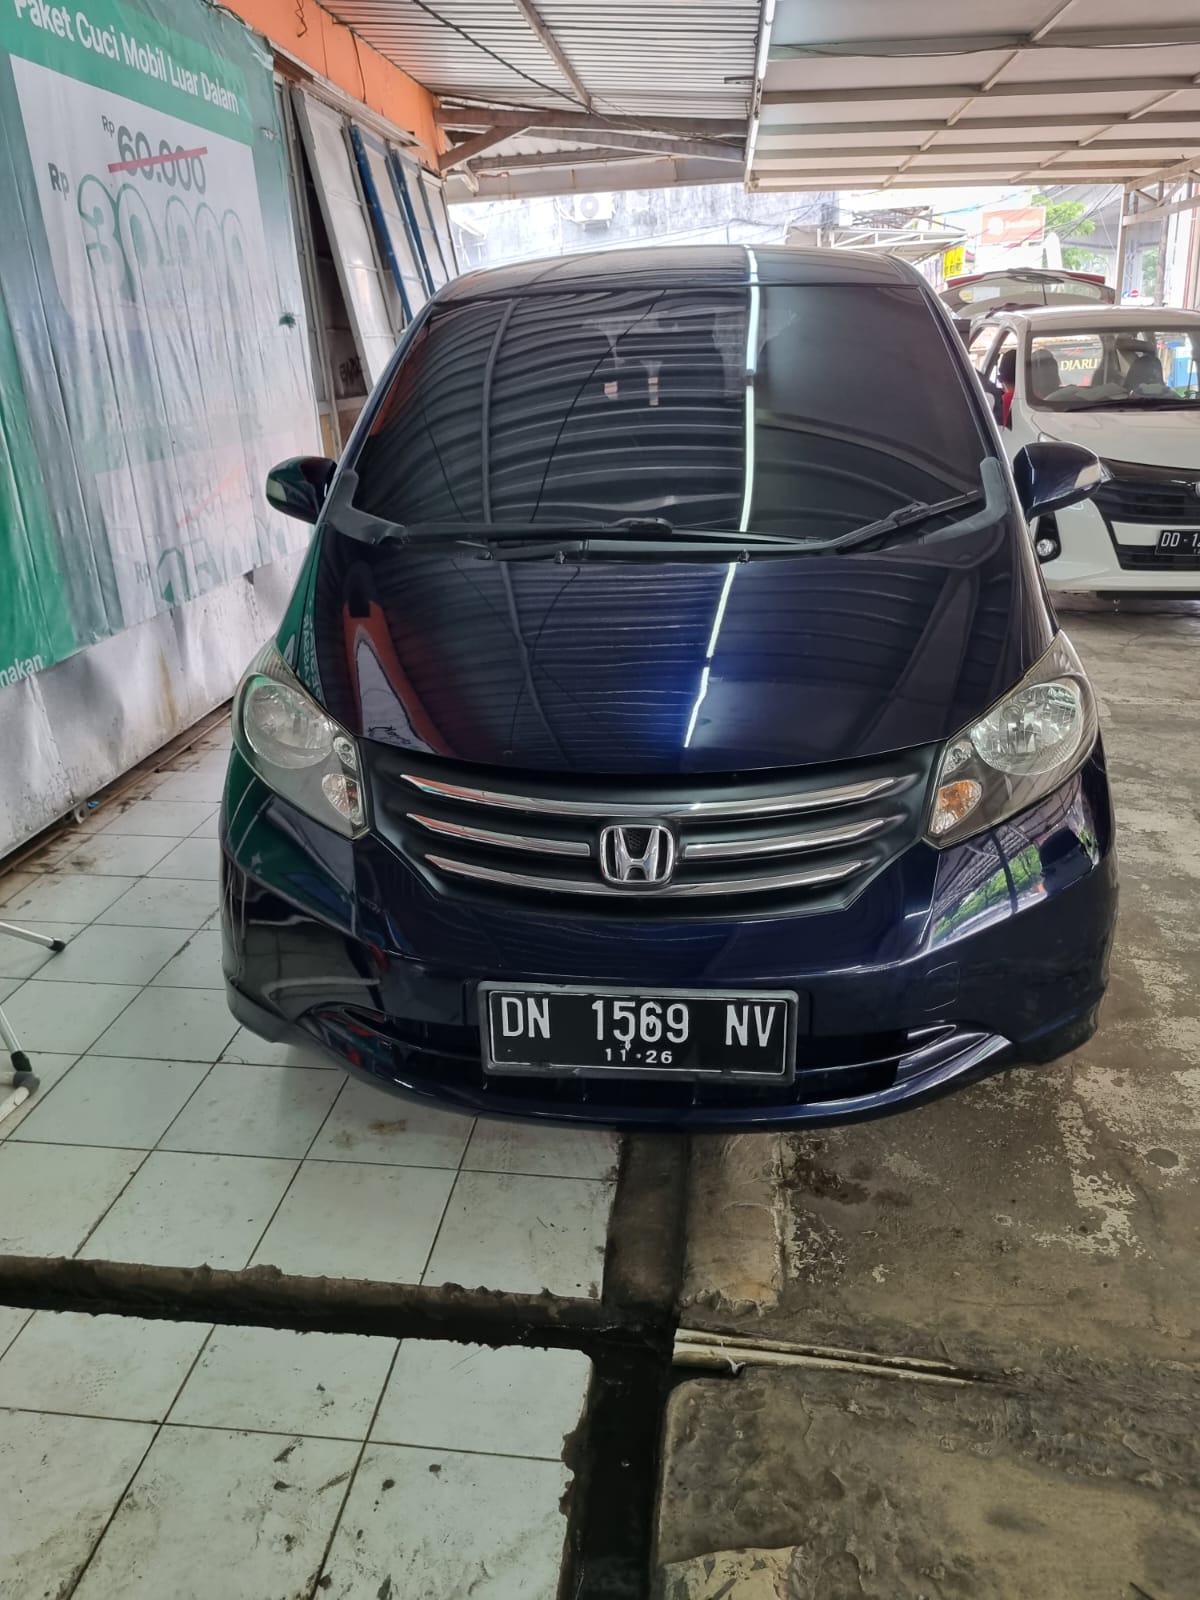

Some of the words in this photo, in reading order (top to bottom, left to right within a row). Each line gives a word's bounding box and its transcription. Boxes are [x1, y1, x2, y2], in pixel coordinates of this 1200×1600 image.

[14, 0, 75, 42] Paket
[76, 12, 120, 62] Cuci
[120, 32, 167, 82] Mobil
[168, 55, 198, 96] Luar
[200, 71, 240, 115] Dalam
[102, 115, 115, 138] Rp
[117, 126, 206, 194] 60.000
[48, 162, 70, 200] Rp
[1161, 532, 1180, 547] DD
[501, 997, 551, 1039] DN
[592, 999, 690, 1043] 1569
[726, 1004, 775, 1047] NV
